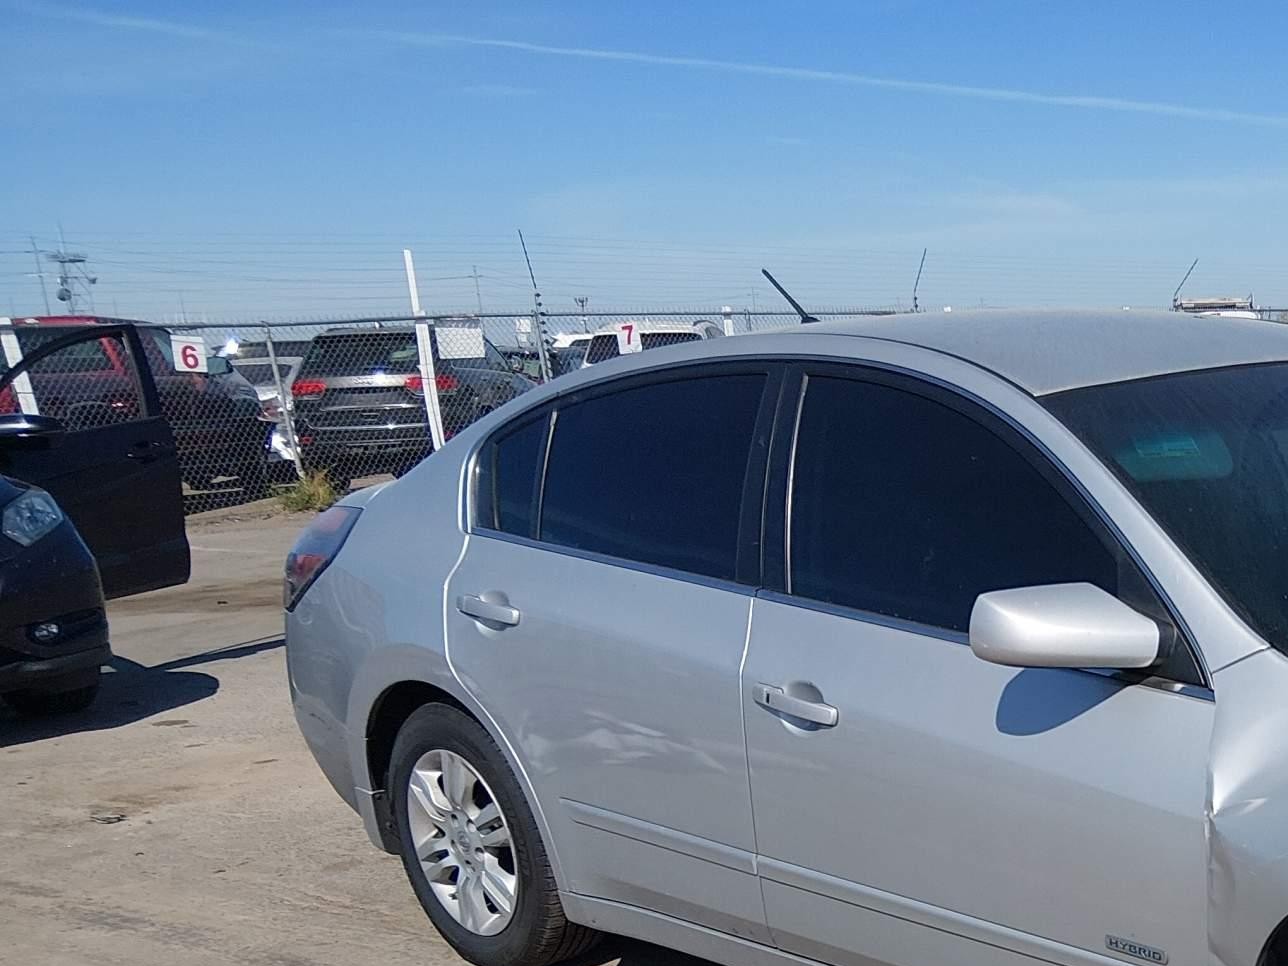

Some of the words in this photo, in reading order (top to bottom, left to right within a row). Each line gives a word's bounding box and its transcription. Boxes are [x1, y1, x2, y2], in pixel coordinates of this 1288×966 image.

[621, 324, 633, 345] 7
[181, 345, 199, 369] 6
[1109, 938, 1162, 961] HYBRID
